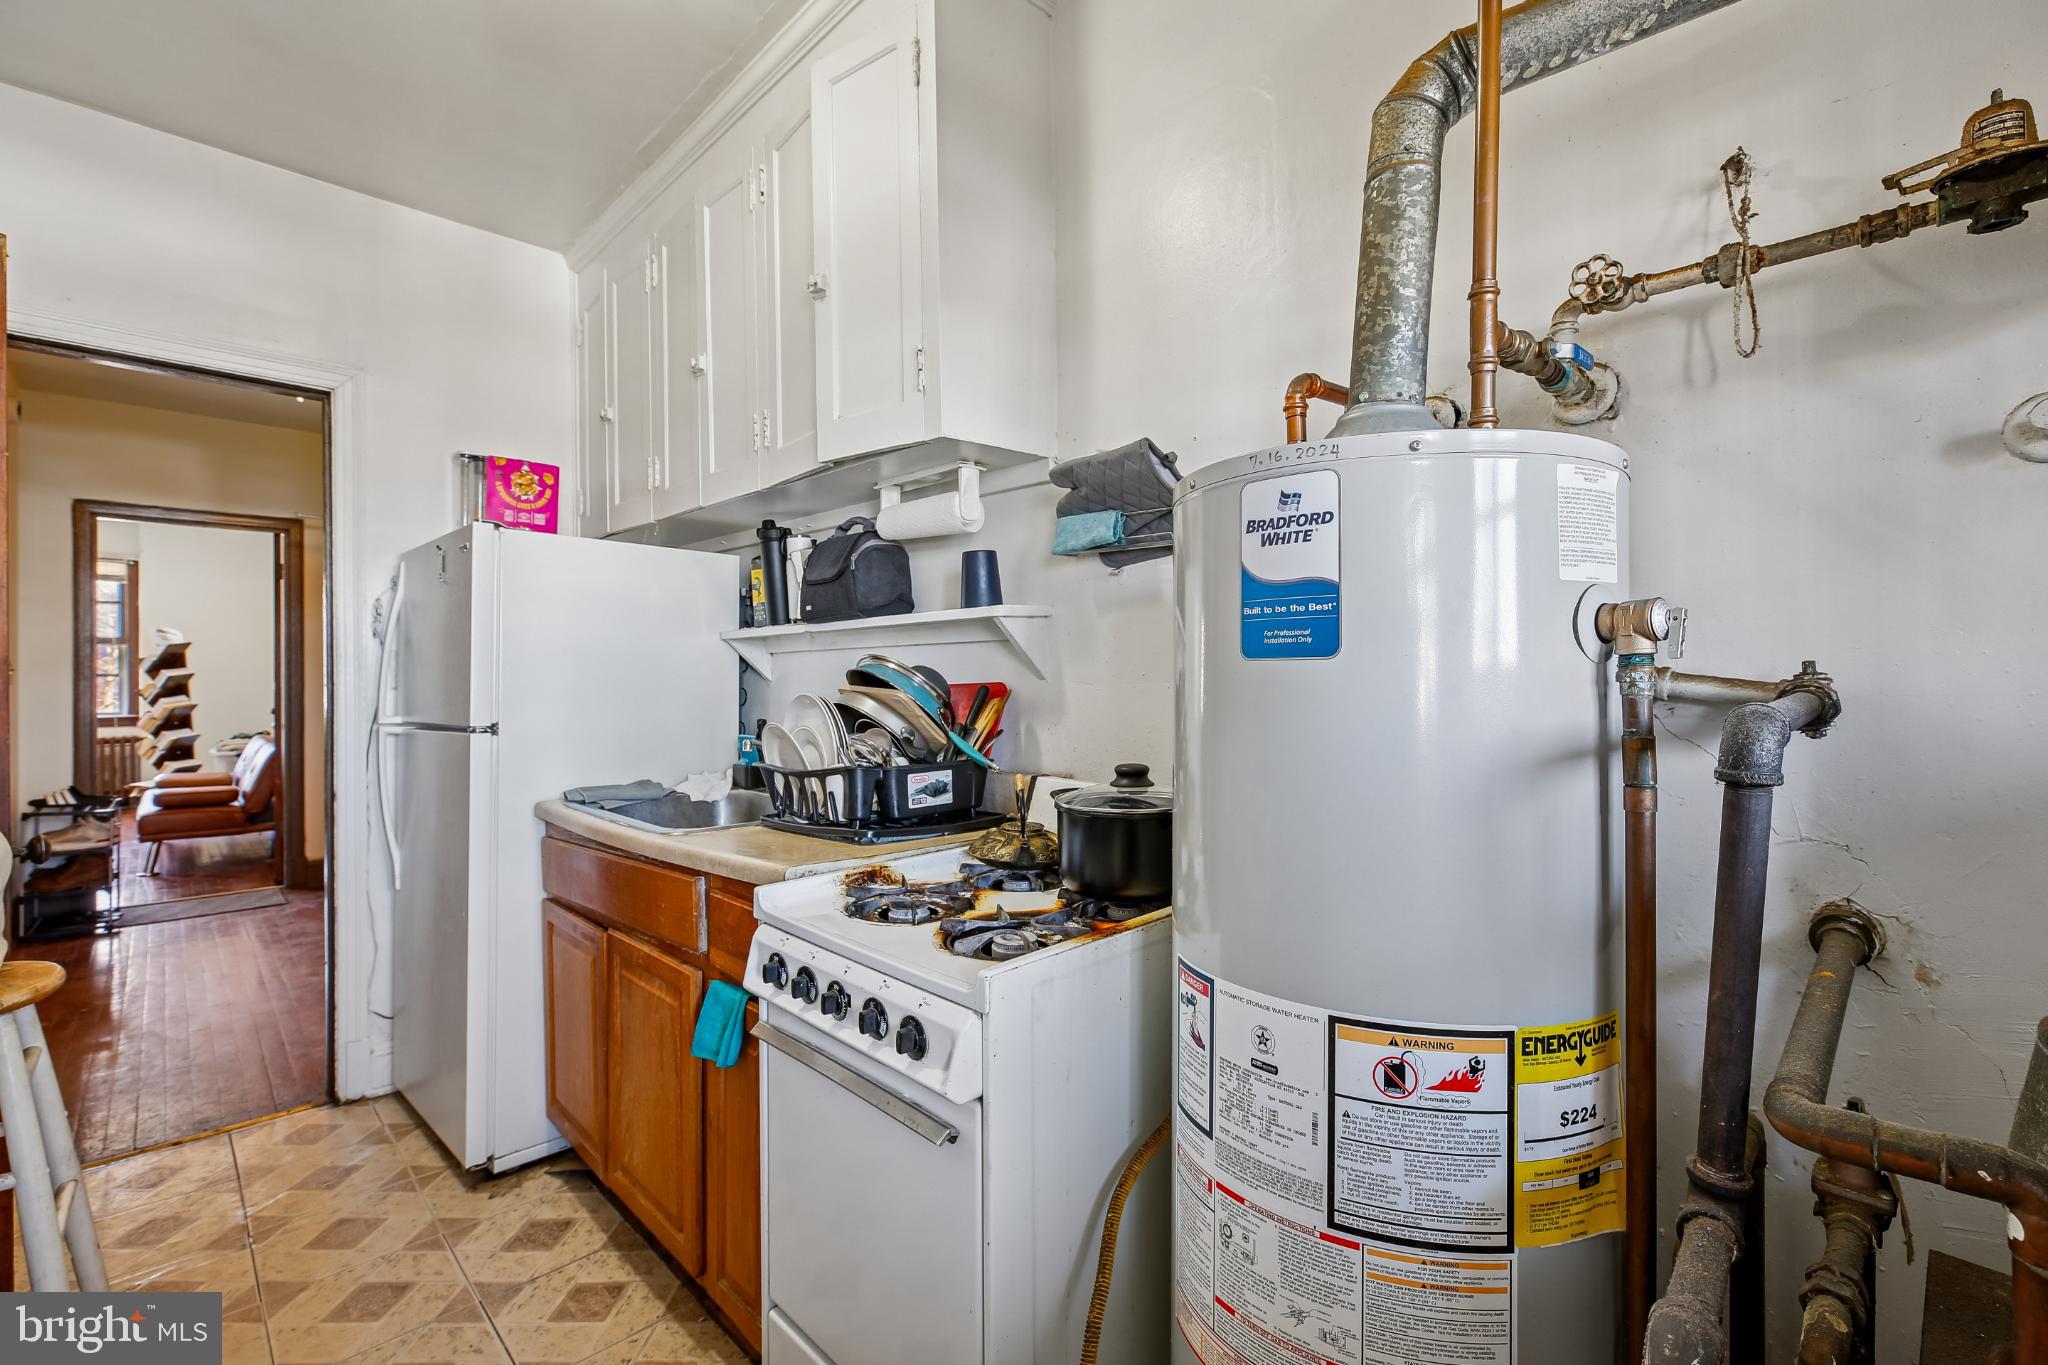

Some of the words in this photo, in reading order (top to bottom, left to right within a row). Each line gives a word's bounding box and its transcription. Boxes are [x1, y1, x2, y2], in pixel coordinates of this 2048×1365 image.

[1246, 511, 1334, 534] BRADFORD
[1260, 529, 1314, 548] WHITE
[1243, 607, 1261, 615] Built
[1275, 605, 1287, 613] be
[1290, 604, 1306, 612] the
[1274, 628, 1311, 636] Professional
[1298, 636, 1312, 644] Only
[1219, 988, 1245, 1004] AUTOMATIC
[1246, 998, 1271, 1012] STORAGE
[1271, 1007, 1293, 1018] WATER
[1293, 1013, 1319, 1024] HEATER
[1402, 1038, 1455, 1051] WARNING
[1521, 1019, 1617, 1059] ENERGYGUIDE
[1419, 1095, 1450, 1103] Flammable
[1451, 1097, 1470, 1105] Vapors
[1371, 1105, 1385, 1113] FIRE
[1402, 1110, 1439, 1119] EXPLOSION
[1560, 1104, 1597, 1129] $224
[1430, 1260, 1460, 1268] WARNING
[1430, 1284, 1459, 1292] WARNING
